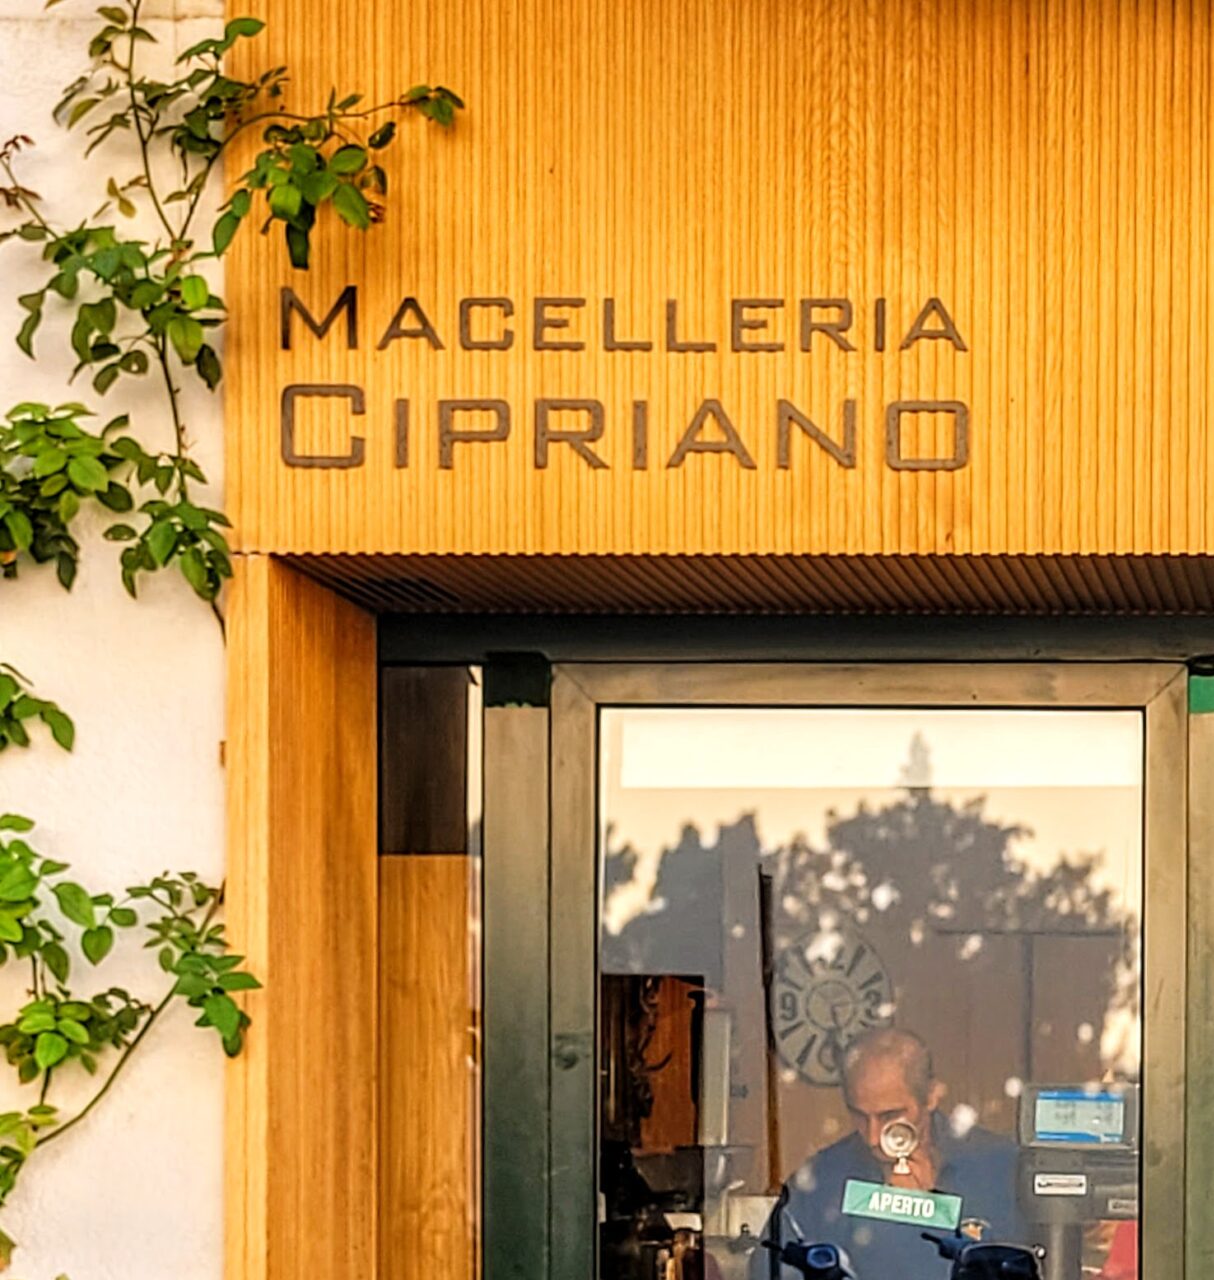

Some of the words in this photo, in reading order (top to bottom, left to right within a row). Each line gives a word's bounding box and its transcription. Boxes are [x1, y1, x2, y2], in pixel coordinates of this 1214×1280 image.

[279, 284, 970, 353] MACELLERIA
[280, 383, 971, 473] CIPRIANO
[780, 992, 798, 1021] 9
[868, 1191, 935, 1218] APERTO
